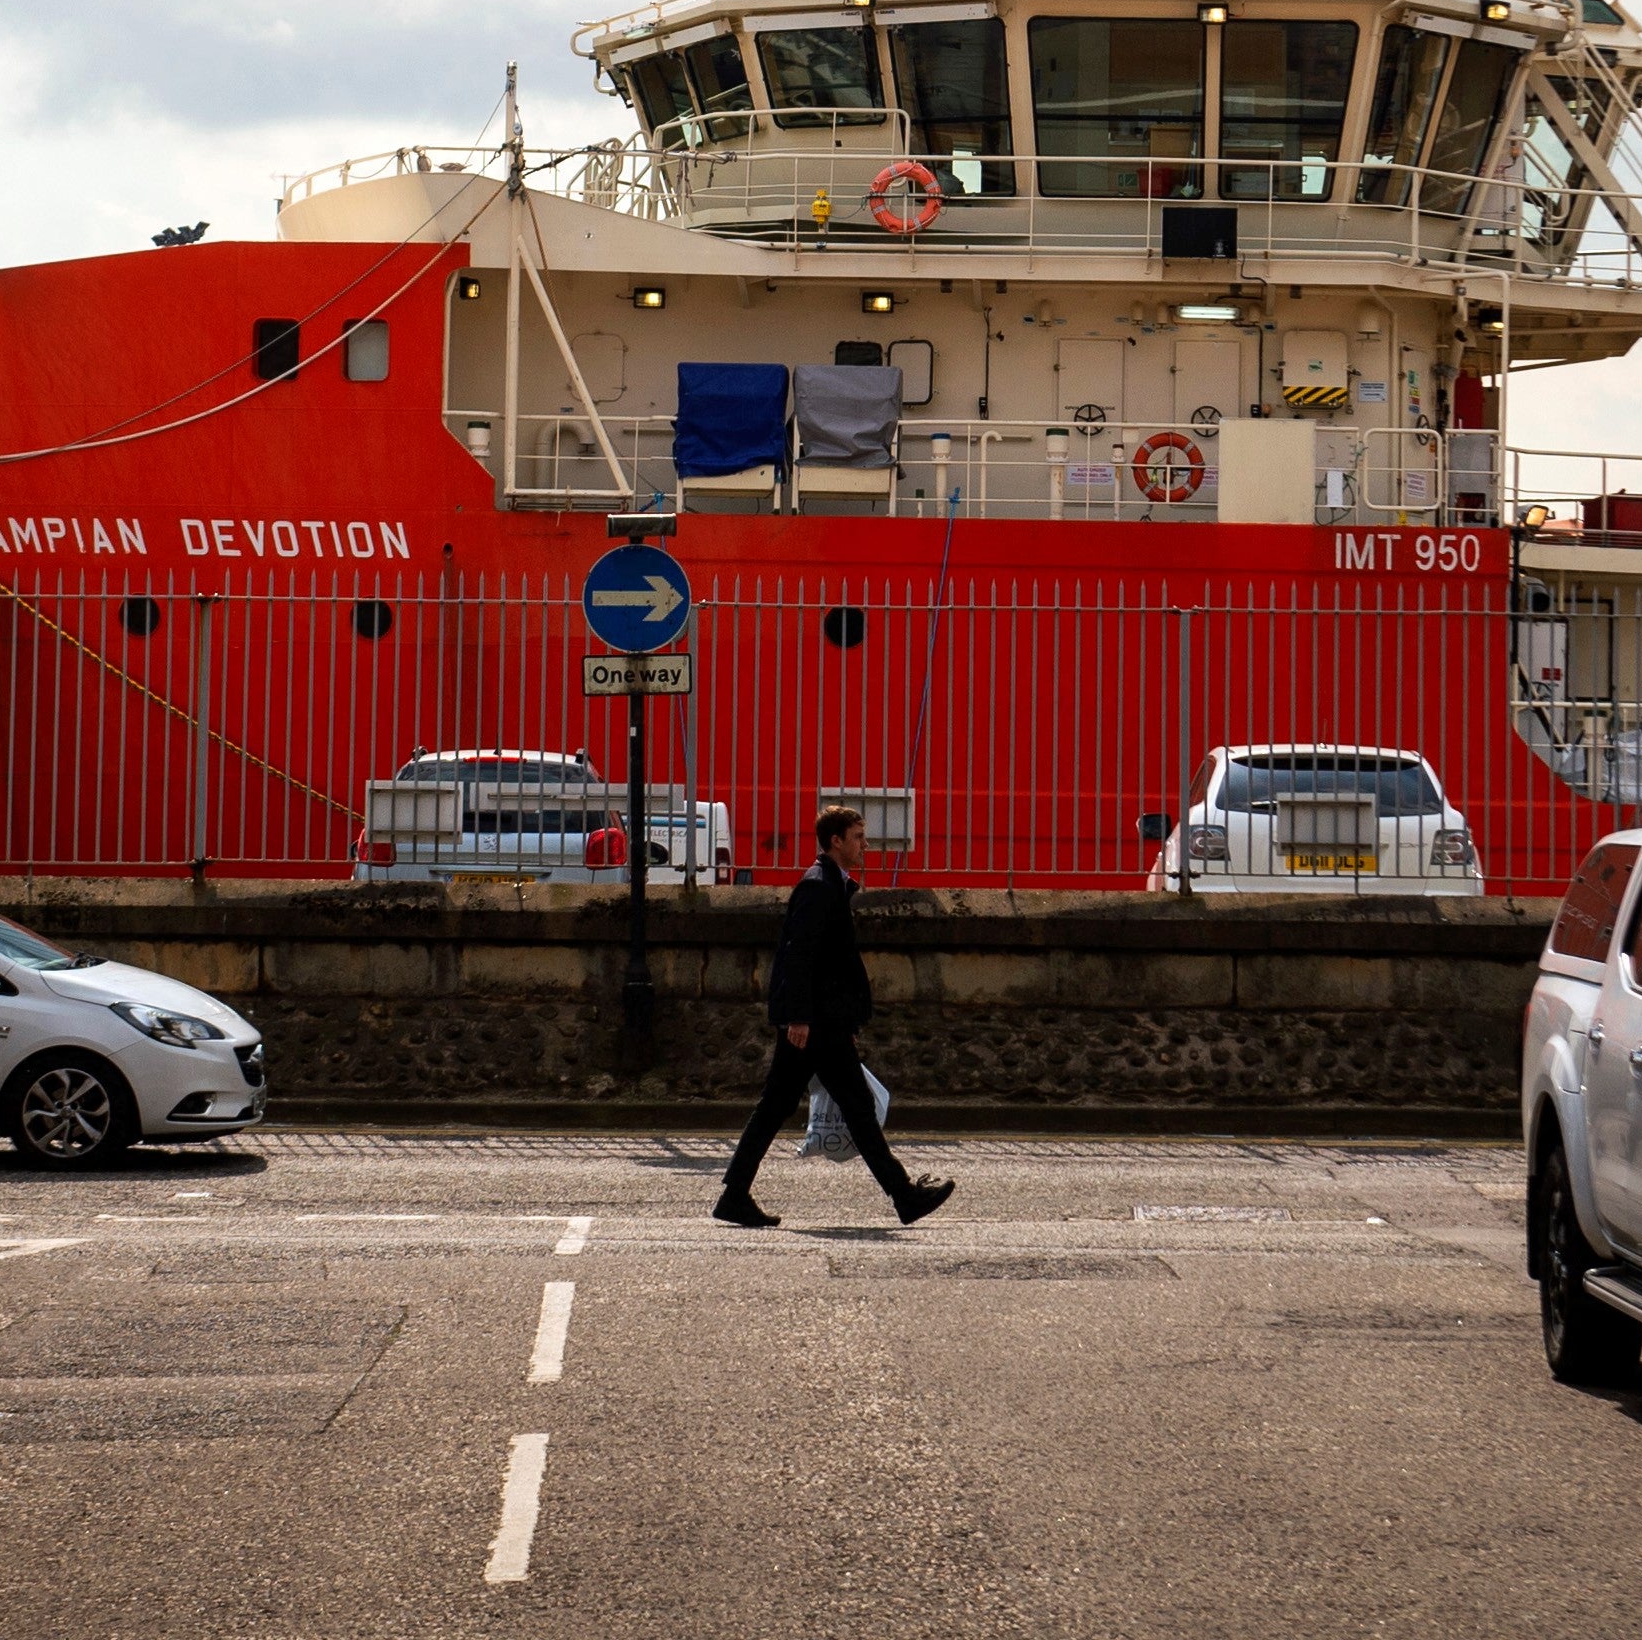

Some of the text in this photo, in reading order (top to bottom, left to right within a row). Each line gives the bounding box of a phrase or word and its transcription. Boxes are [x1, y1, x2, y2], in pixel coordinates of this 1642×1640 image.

[180, 518, 411, 559] DEVOTION
[1335, 533, 1480, 572] IMT 950
[592, 666, 682, 686] One way
